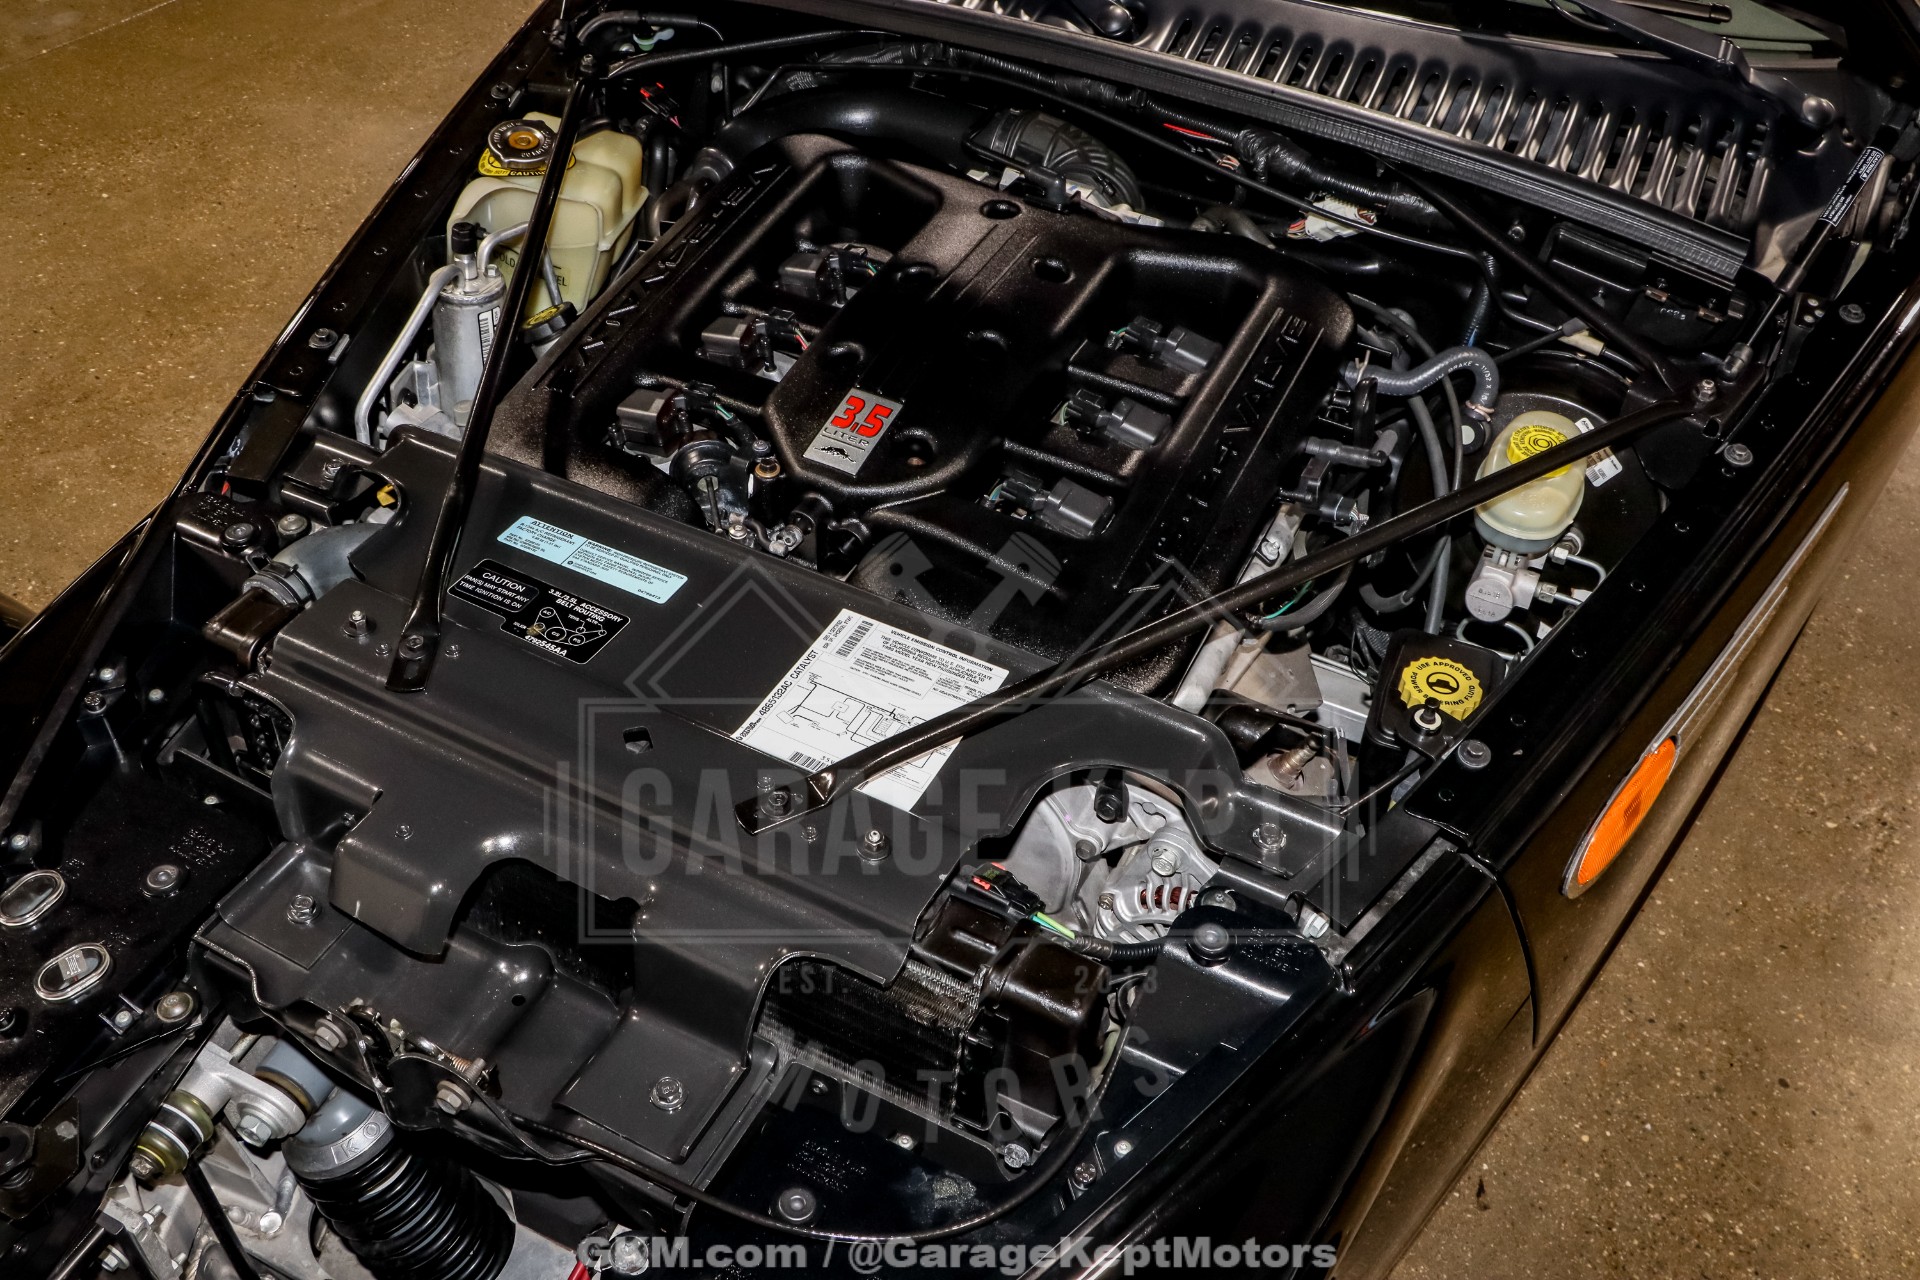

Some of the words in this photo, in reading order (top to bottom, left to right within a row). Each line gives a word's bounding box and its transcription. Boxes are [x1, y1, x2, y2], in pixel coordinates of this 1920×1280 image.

[830, 395, 893, 438] 3.5
[823, 427, 870, 446] LITER
[530, 520, 575, 539] ATTENTION
[458, 580, 475, 590] TIME
[474, 586, 504, 602] IGNITION
[509, 601, 522, 609] ON
[463, 574, 484, 586] FAN(S)
[482, 582, 498, 591] MAY
[495, 586, 517, 598] START
[513, 594, 530, 603] ANY
[480, 570, 526, 594] CAUTION
[554, 598, 574, 608] BELT
[572, 605, 606, 622] ROUTING
[578, 601, 623, 623] ACCESSORY
[888, 629, 911, 640] VEHICLE
[909, 637, 936, 650] EMISSION
[934, 646, 959, 659] CONTROL
[957, 655, 994, 672] INFORMATION
[790, 650, 818, 678] CATALYST
[1416, 662, 1430, 670] USE
[1433, 662, 1472, 681] APPROVED
[1410, 672, 1424, 694] POWER
[1464, 685, 1476, 702] FLUID
